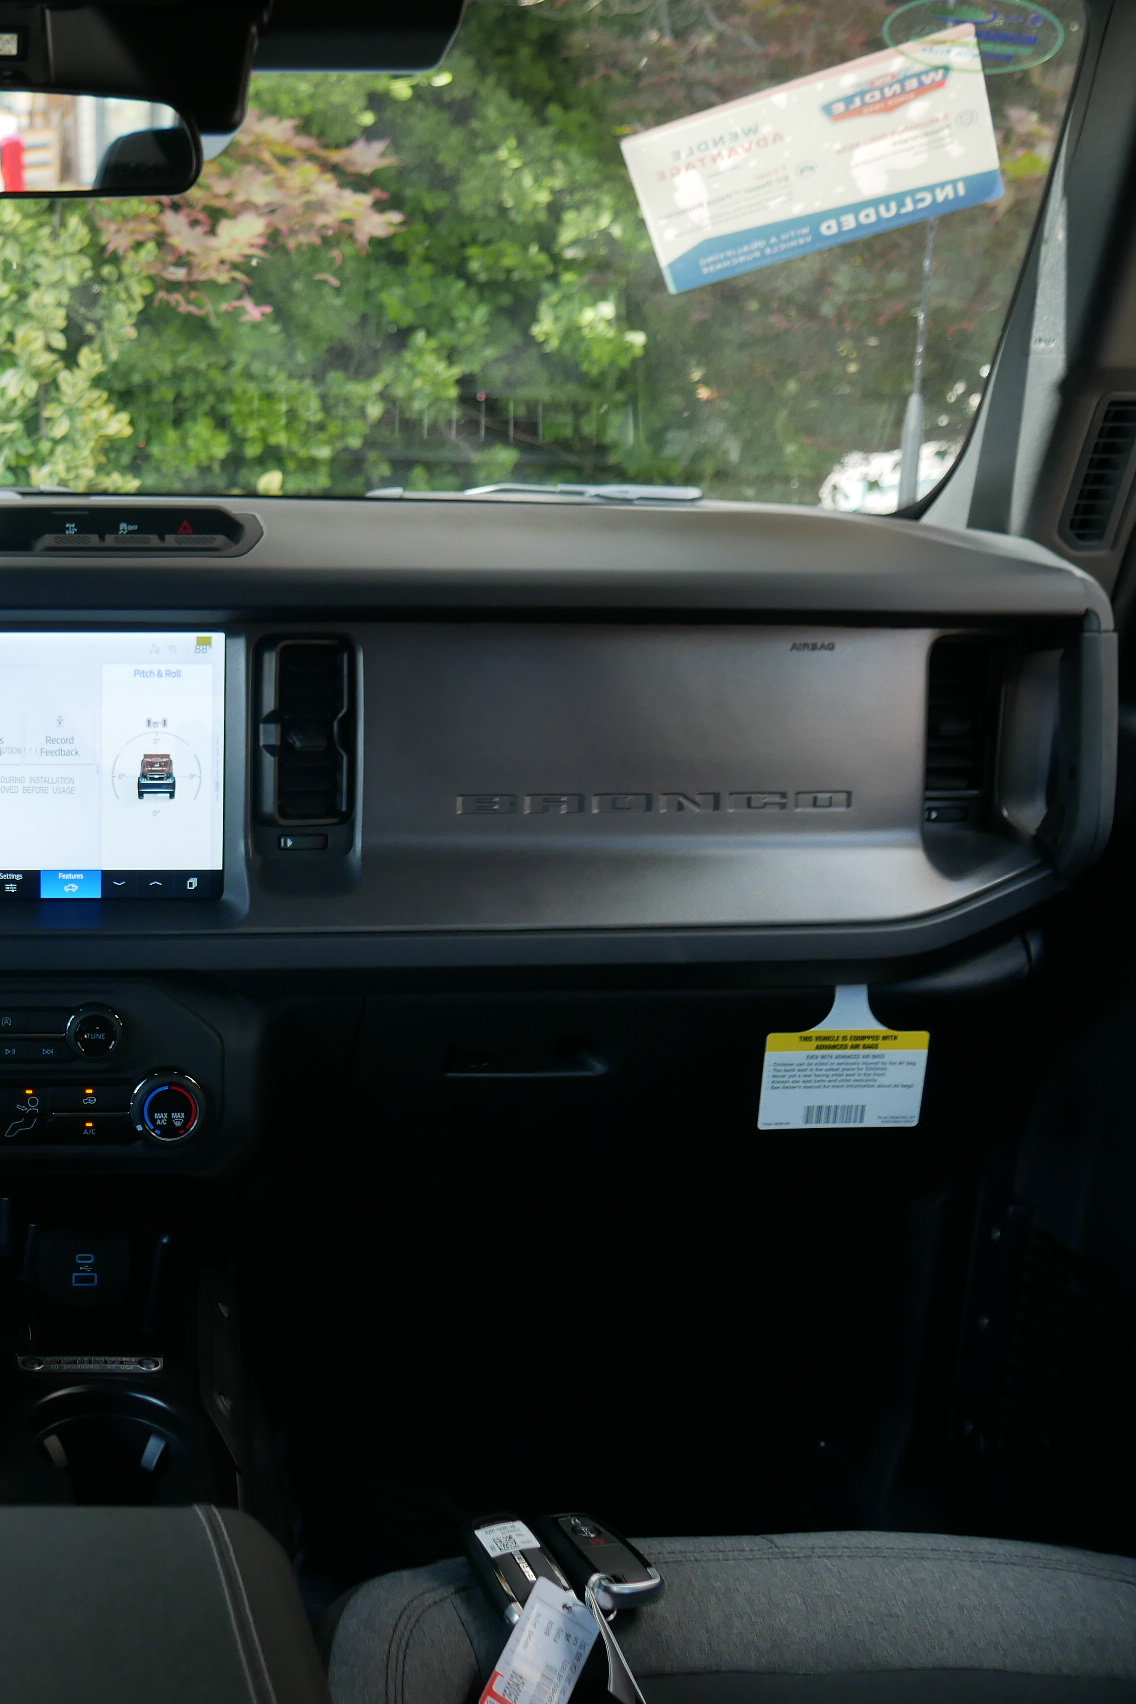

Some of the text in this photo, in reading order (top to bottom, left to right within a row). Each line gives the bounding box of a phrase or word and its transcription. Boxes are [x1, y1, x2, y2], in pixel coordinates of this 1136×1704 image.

[133, 669, 182, 678] Pitch & Roll
[45, 736, 74, 745] Record
[40, 748, 80, 757] Feedback
[0, 775, 26, 784] DURING
[28, 775, 75, 784] INSTALLATION
[21, 785, 49, 794] BEFORE
[52, 785, 75, 794] USAGE
[456, 790, 852, 816] BRONCO
[0, 873, 23, 881] Settings
[87, 1032, 106, 1040] TUNE
